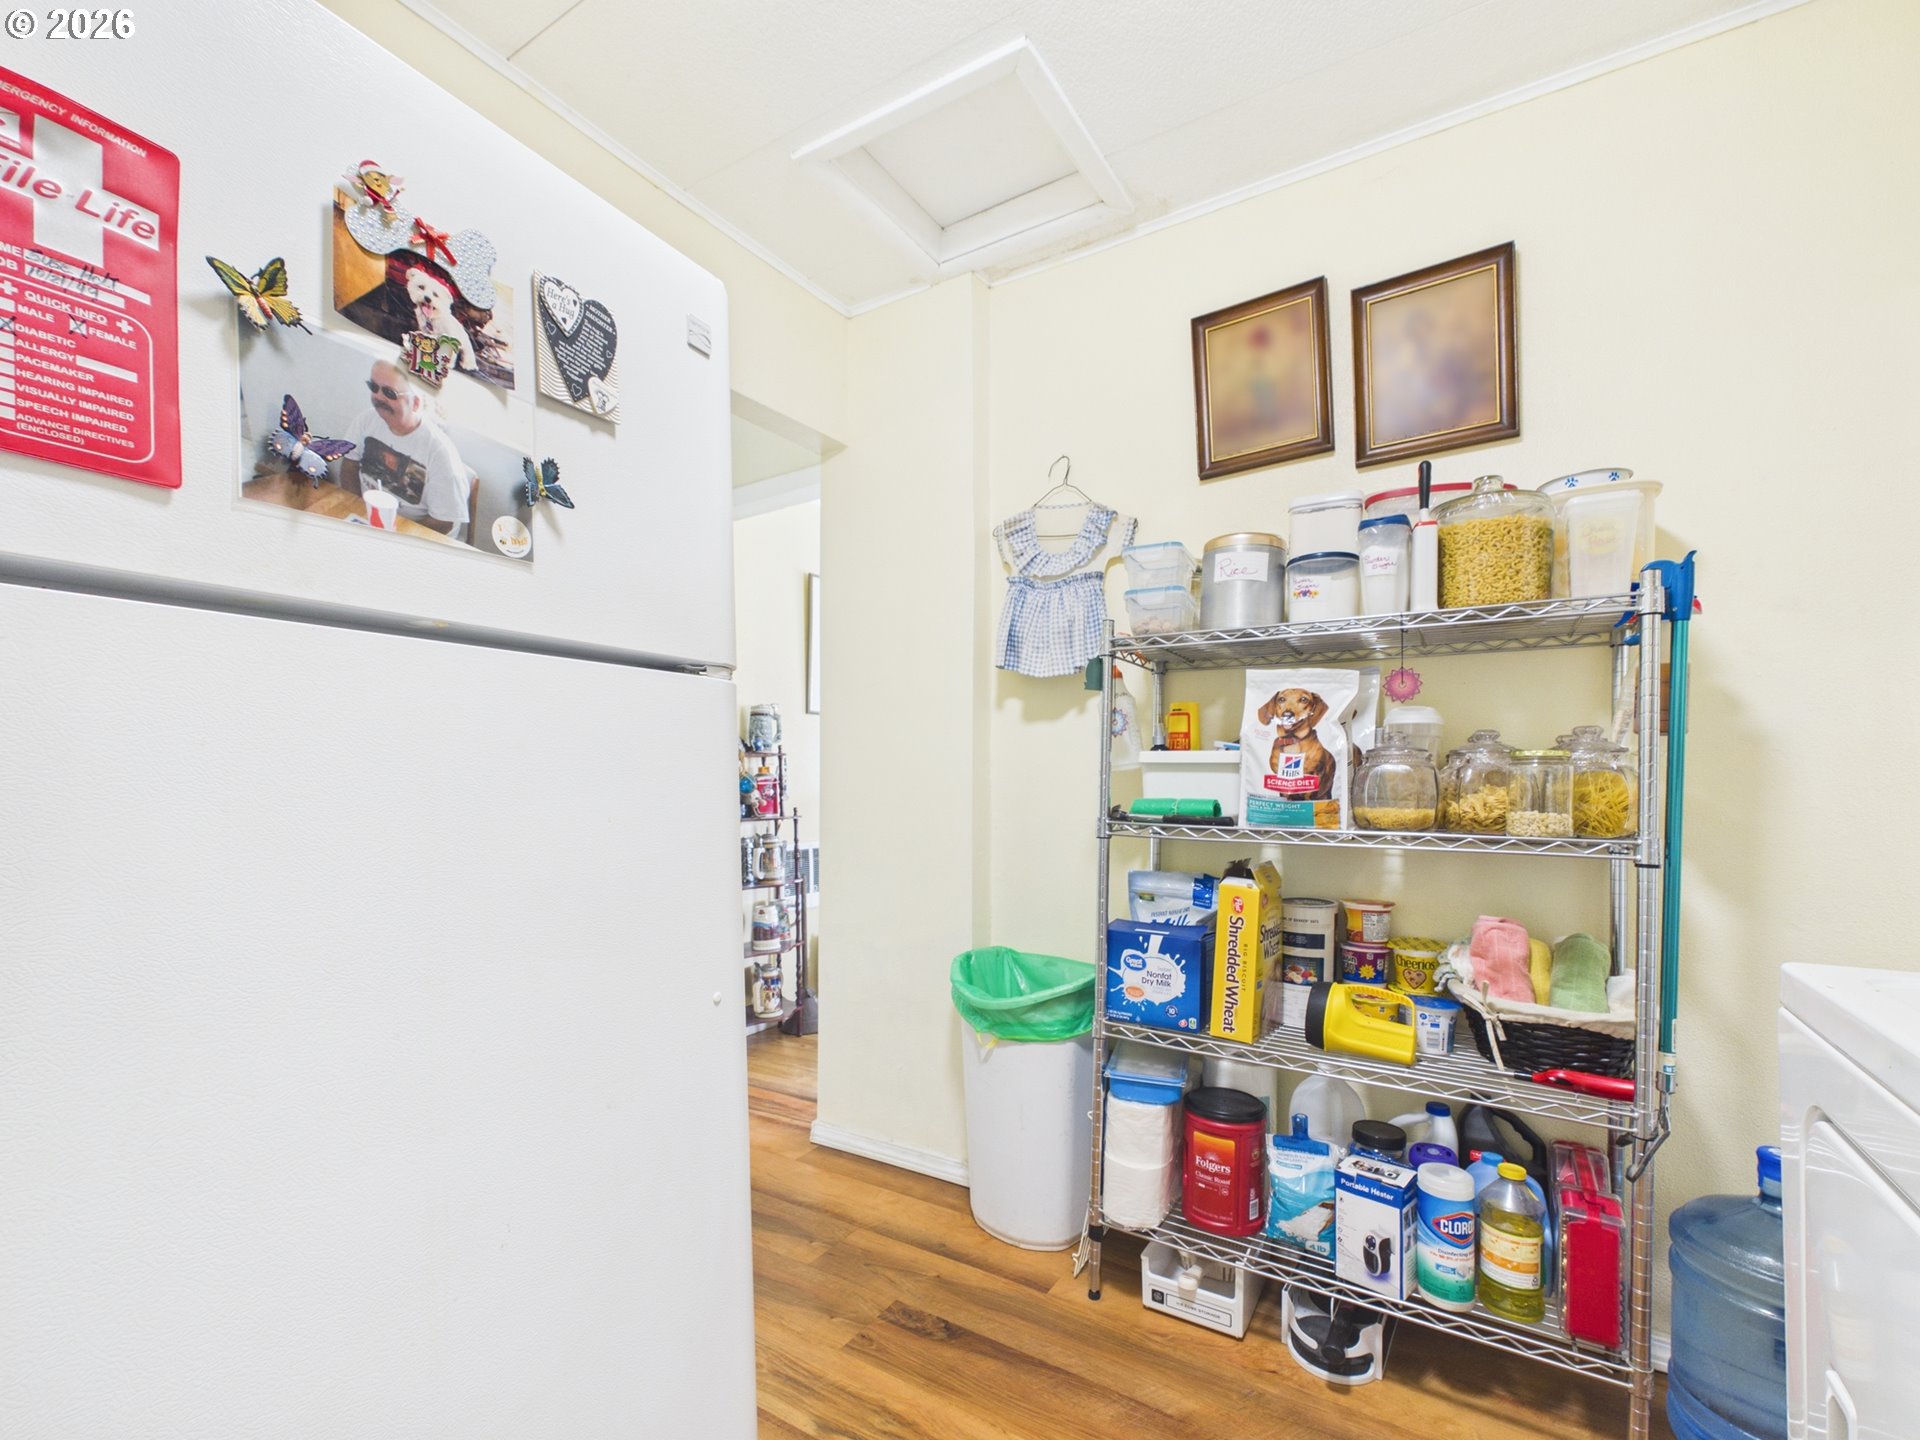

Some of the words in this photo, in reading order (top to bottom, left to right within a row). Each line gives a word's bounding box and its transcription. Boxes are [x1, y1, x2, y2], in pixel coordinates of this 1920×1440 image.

[70, 113, 147, 158] INFORMATION
[75, 188, 156, 240] Life
[547, 287, 571, 305] Here's
[17, 304, 55, 322] MALE
[24, 290, 71, 312] QUICK
[75, 306, 108, 325] INFO
[552, 302, 557, 310] a
[559, 302, 575, 320] Hug
[15, 323, 76, 348] DIABETIC
[88, 327, 137, 349] FEMALE
[15, 339, 75, 362] ALLERGY
[16, 353, 95, 382] PACEMAKER
[16, 368, 75, 391] HEARING
[78, 385, 134, 408] IMPAIRED
[16, 383, 76, 405] VISUALLY
[79, 400, 135, 422] IMPAIRED
[16, 398, 69, 418] SPEECH
[72, 412, 128, 433] IMPAIRED
[16, 413, 71, 433] ADVANCE
[73, 428, 135, 449] DIRECTIVES
[16, 422, 85, 445] (ENCLOSED)
[1217, 556, 1257, 577] Rice
[1266, 778, 1296, 787] SCIENCE
[1297, 779, 1315, 787] DIET
[1281, 769, 1301, 778] Hill's
[1249, 799, 1274, 808] PERFECT
[1225, 915, 1245, 986] Shredded
[1395, 953, 1436, 971] Cheerios
[1141, 976, 1154, 987] Dry
[1156, 978, 1171, 988] Milk
[1146, 970, 1172, 981] Nonfat
[1241, 961, 1249, 992] BISCUIT
[1223, 985, 1240, 1033] Wheat
[1195, 1155, 1231, 1174] Folgers
[1195, 1170, 1213, 1182] Classic
[1214, 1176, 1230, 1185] Roast
[1341, 1177, 1369, 1194] Portable
[1309, 1243, 1316, 1251] 4
[1317, 1243, 1326, 1253] lb
